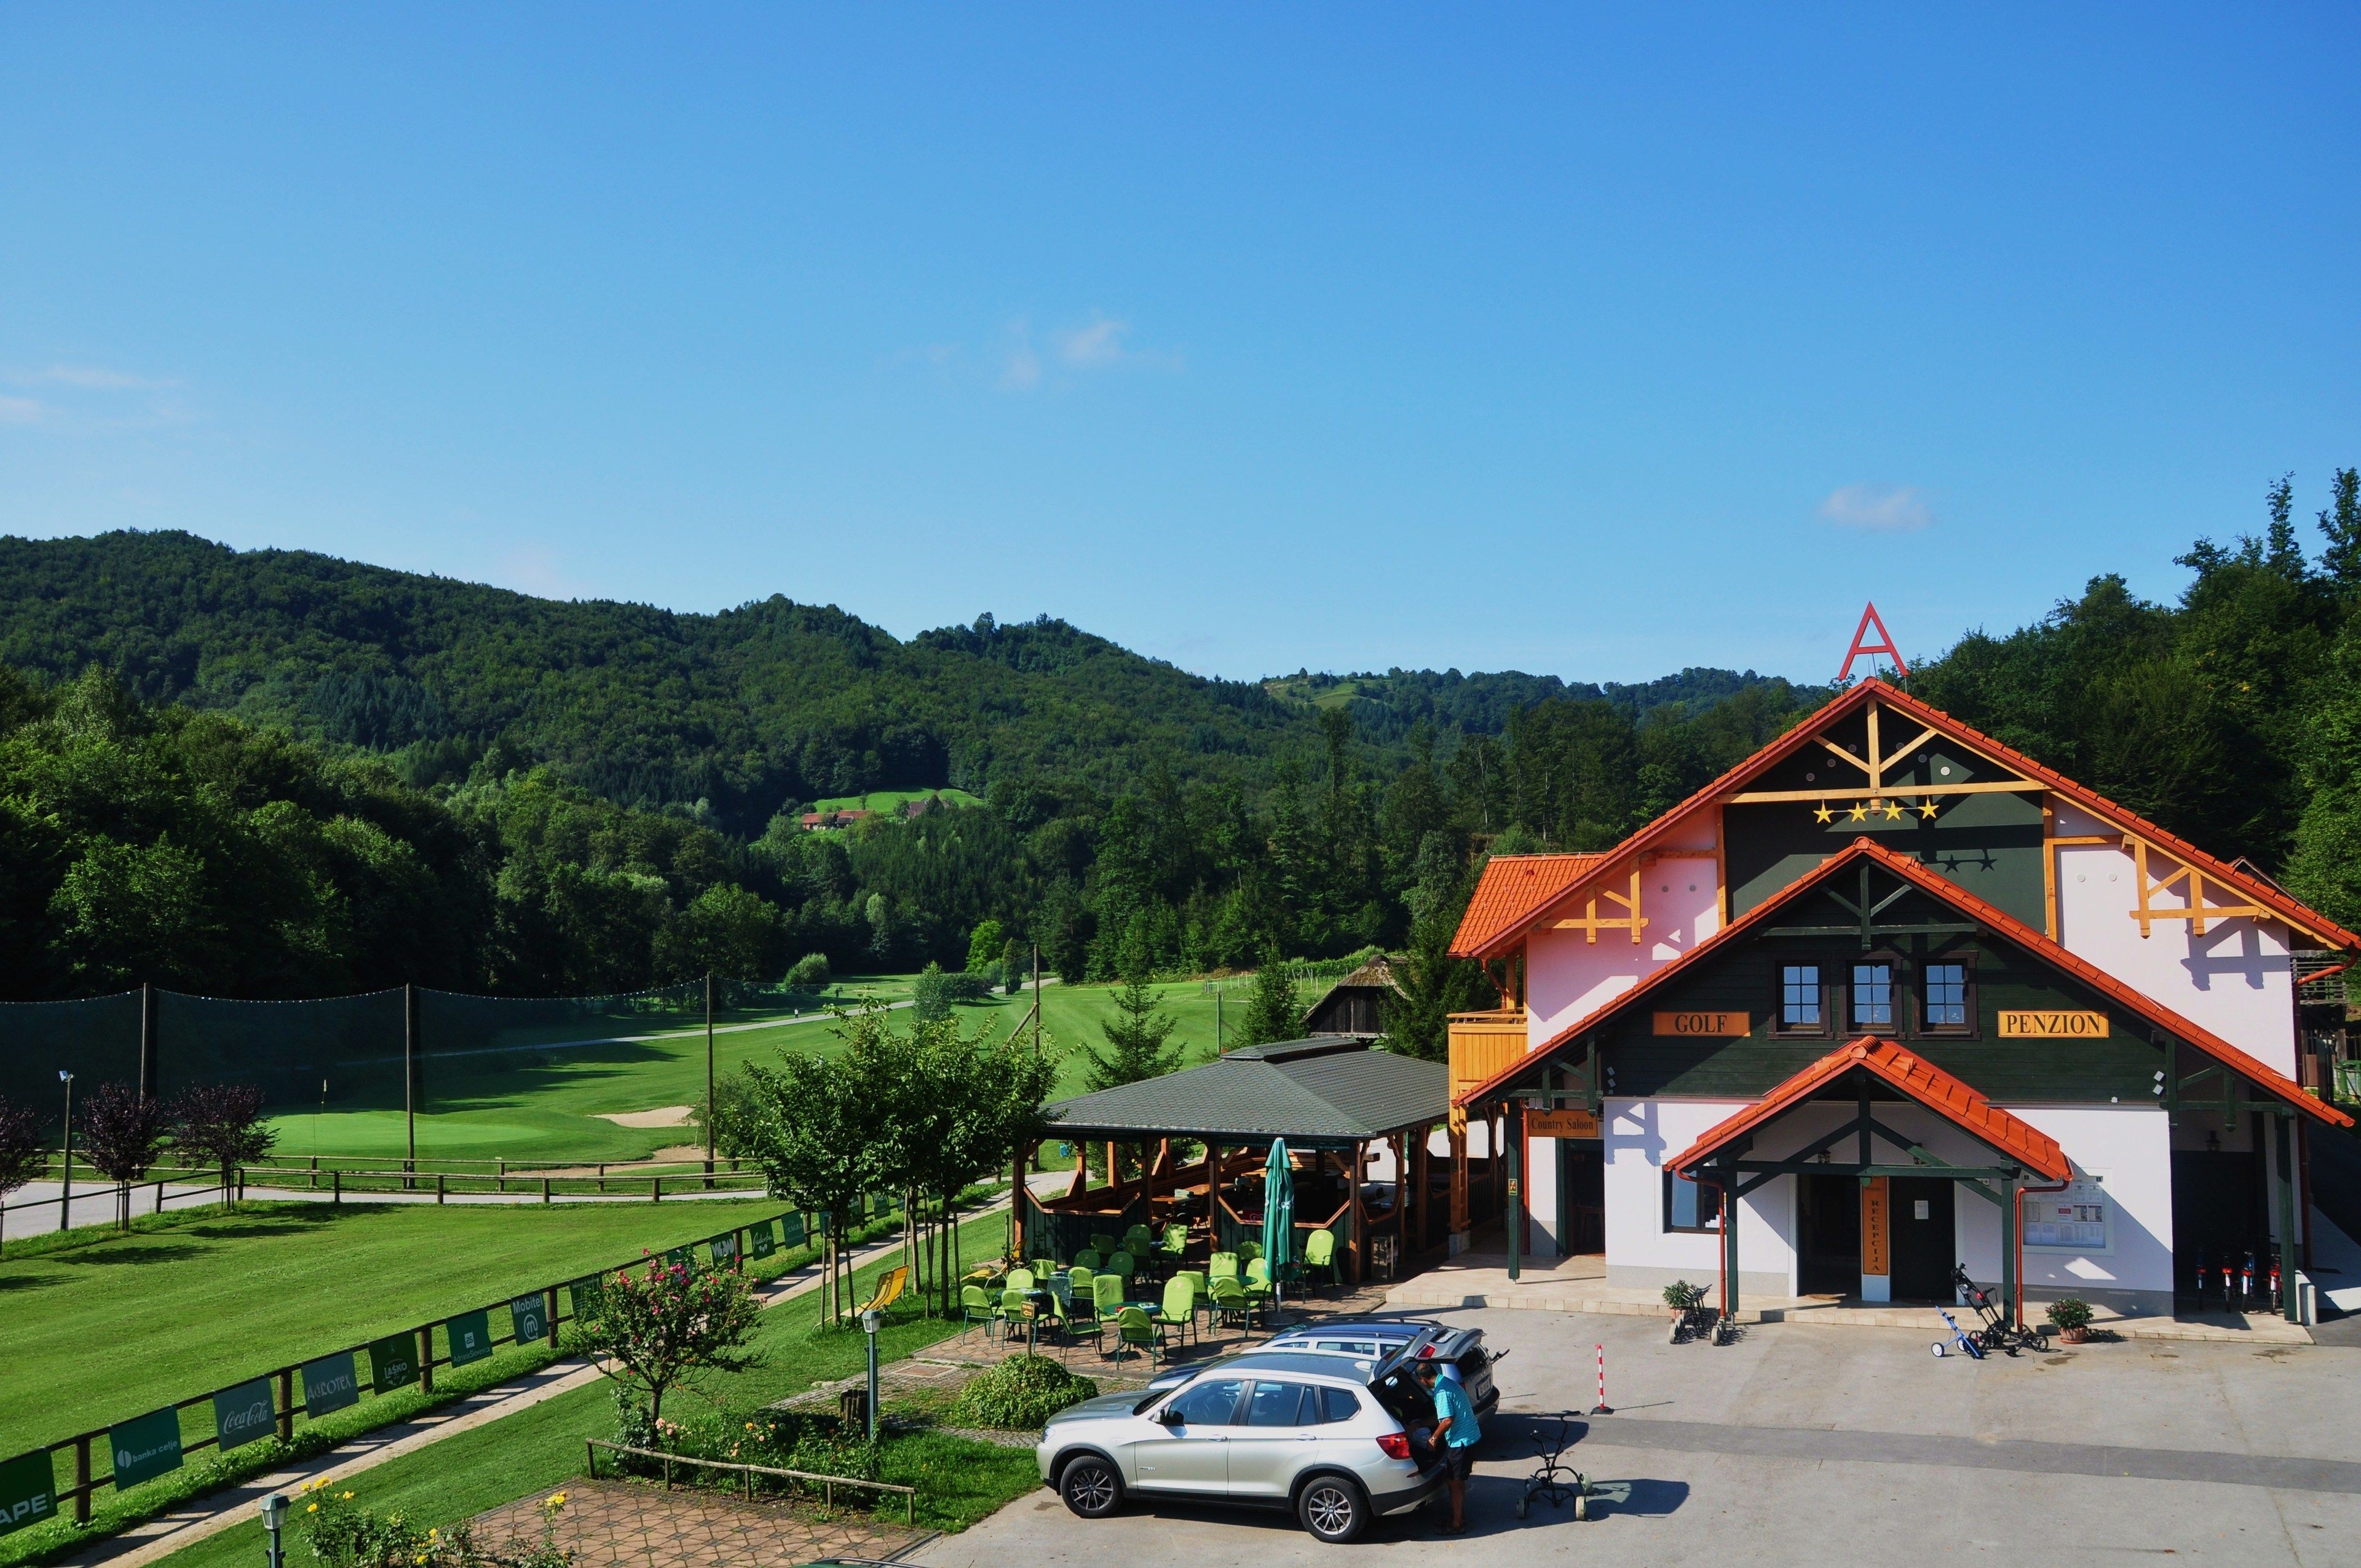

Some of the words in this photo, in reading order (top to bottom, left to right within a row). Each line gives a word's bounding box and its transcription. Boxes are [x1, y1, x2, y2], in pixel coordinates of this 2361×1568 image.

[1674, 1014, 1728, 1033] GOLF
[2006, 1014, 2101, 1034] PENZION
[1531, 1118, 1563, 1133] Country
[1567, 1119, 1594, 1130] Saloon
[1870, 1200, 1880, 1271] RECEPCIJA
[512, 1294, 544, 1315] Mobitel
[384, 1362, 408, 1379] LAŠKO
[307, 1372, 352, 1401] AGROTEX
[132, 1450, 157, 1463] banka
[158, 1440, 178, 1453] celje
